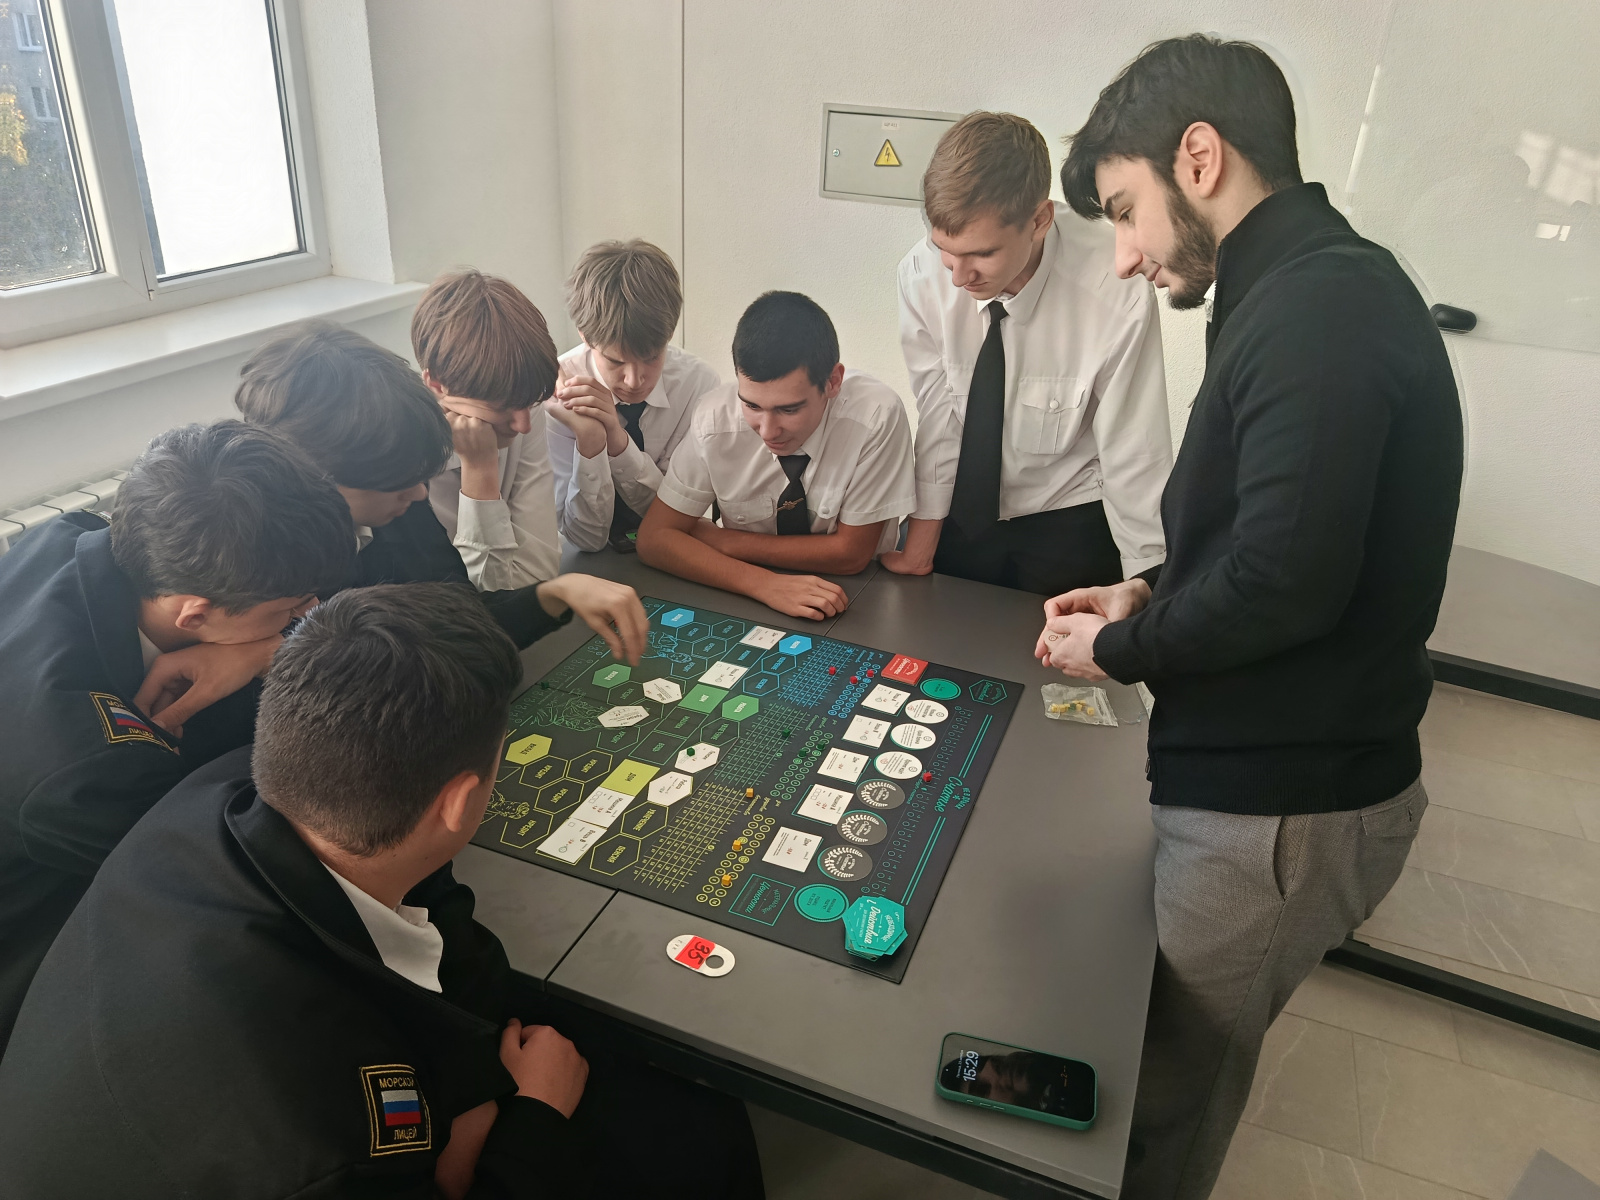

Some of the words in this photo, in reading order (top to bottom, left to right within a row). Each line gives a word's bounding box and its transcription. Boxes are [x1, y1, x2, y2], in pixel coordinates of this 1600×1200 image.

[520, 743, 537, 755] ВКЛАД
[535, 765, 552, 779] КРЕДИТ
[581, 759, 597, 773] КРЕДИТ
[625, 773, 636, 782] ДОМ
[551, 788, 568, 803] КРЕДИТ
[935, 777, 962, 812] Счастье
[518, 820, 536, 836] КРЕДИТ
[633, 809, 656, 831] УВЛЕЧЕНИЕ
[607, 846, 626, 863] ПЕНСИЯ
[745, 882, 770, 913] Ценности
[860, 907, 888, 943] Действия
[688, 941, 711, 965] 35
[962, 1050, 980, 1082] 15:29
[394, 1127, 418, 1141] ЛИЦЕЙ
